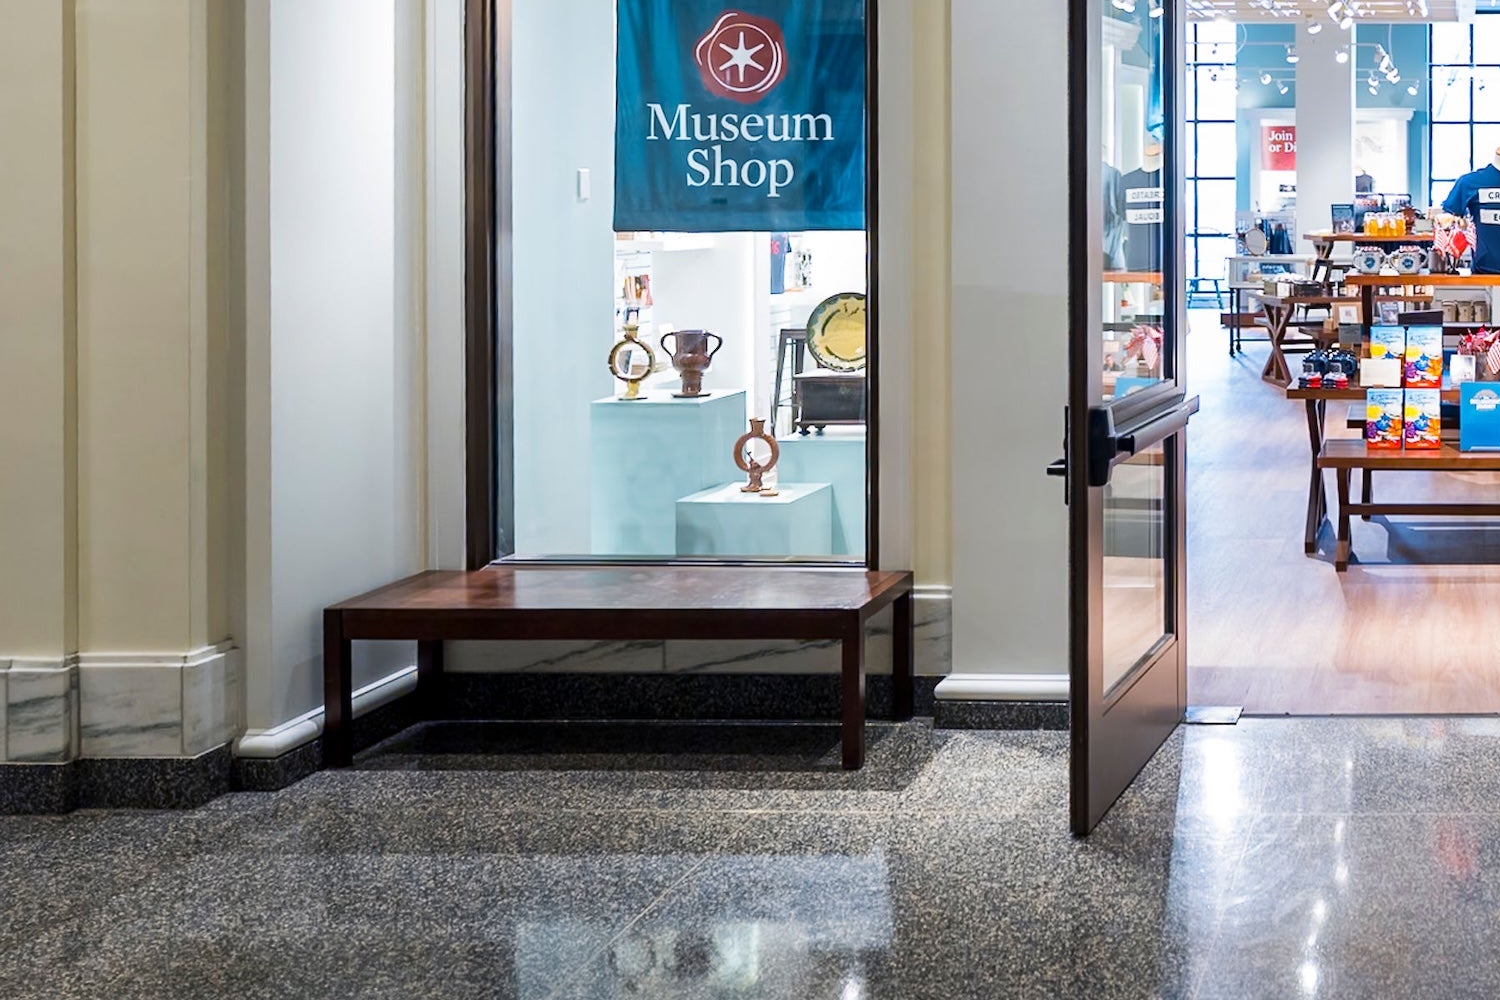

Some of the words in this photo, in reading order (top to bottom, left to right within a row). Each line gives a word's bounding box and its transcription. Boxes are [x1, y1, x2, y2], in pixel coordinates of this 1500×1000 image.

[646, 103, 834, 142] Museum
[1268, 130, 1293, 141] Join
[1268, 143, 1282, 152] or
[686, 144, 795, 197] Shop
